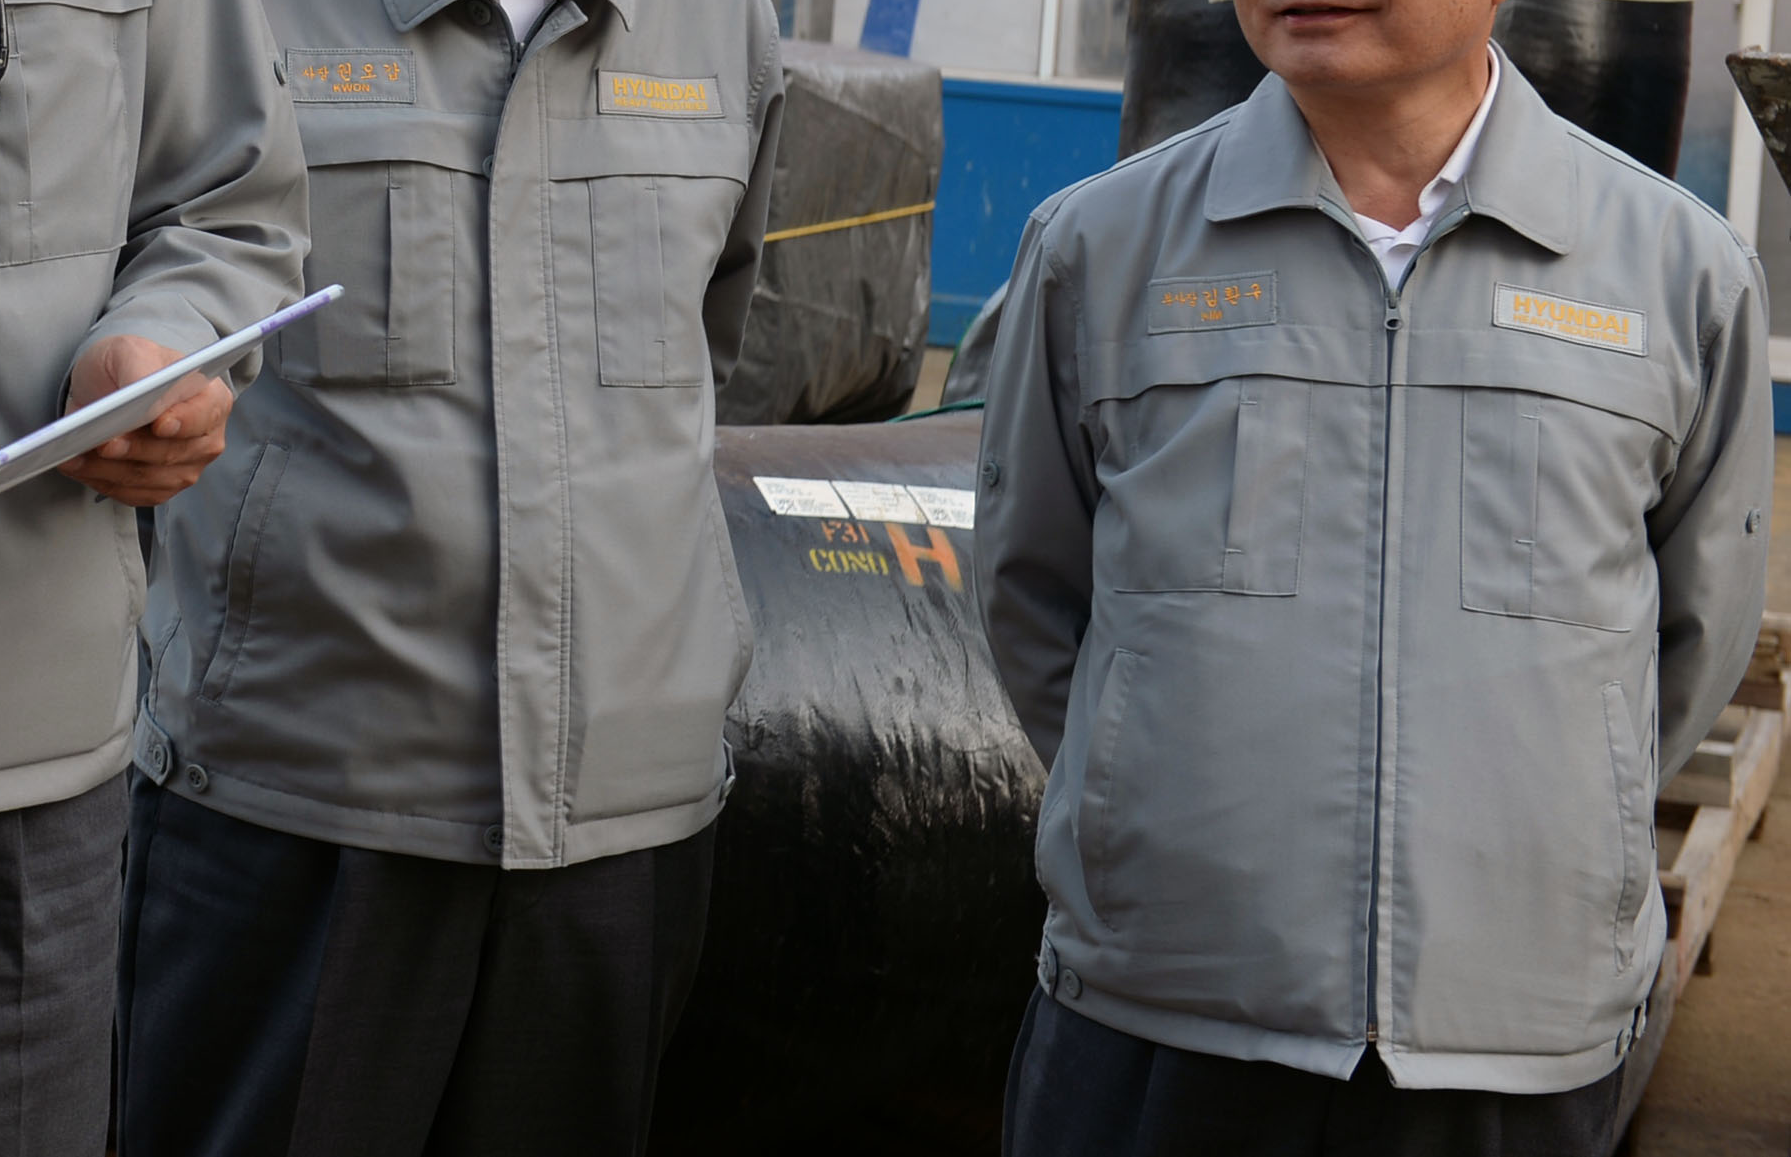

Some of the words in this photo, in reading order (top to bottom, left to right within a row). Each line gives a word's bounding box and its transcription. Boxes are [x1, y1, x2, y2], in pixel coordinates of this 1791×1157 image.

[332, 83, 371, 93] KWON
[613, 77, 706, 100] HYUNDAI
[614, 97, 648, 108] HEAVY
[1513, 294, 1630, 335] HYUNDAI
[884, 521, 964, 593] H
